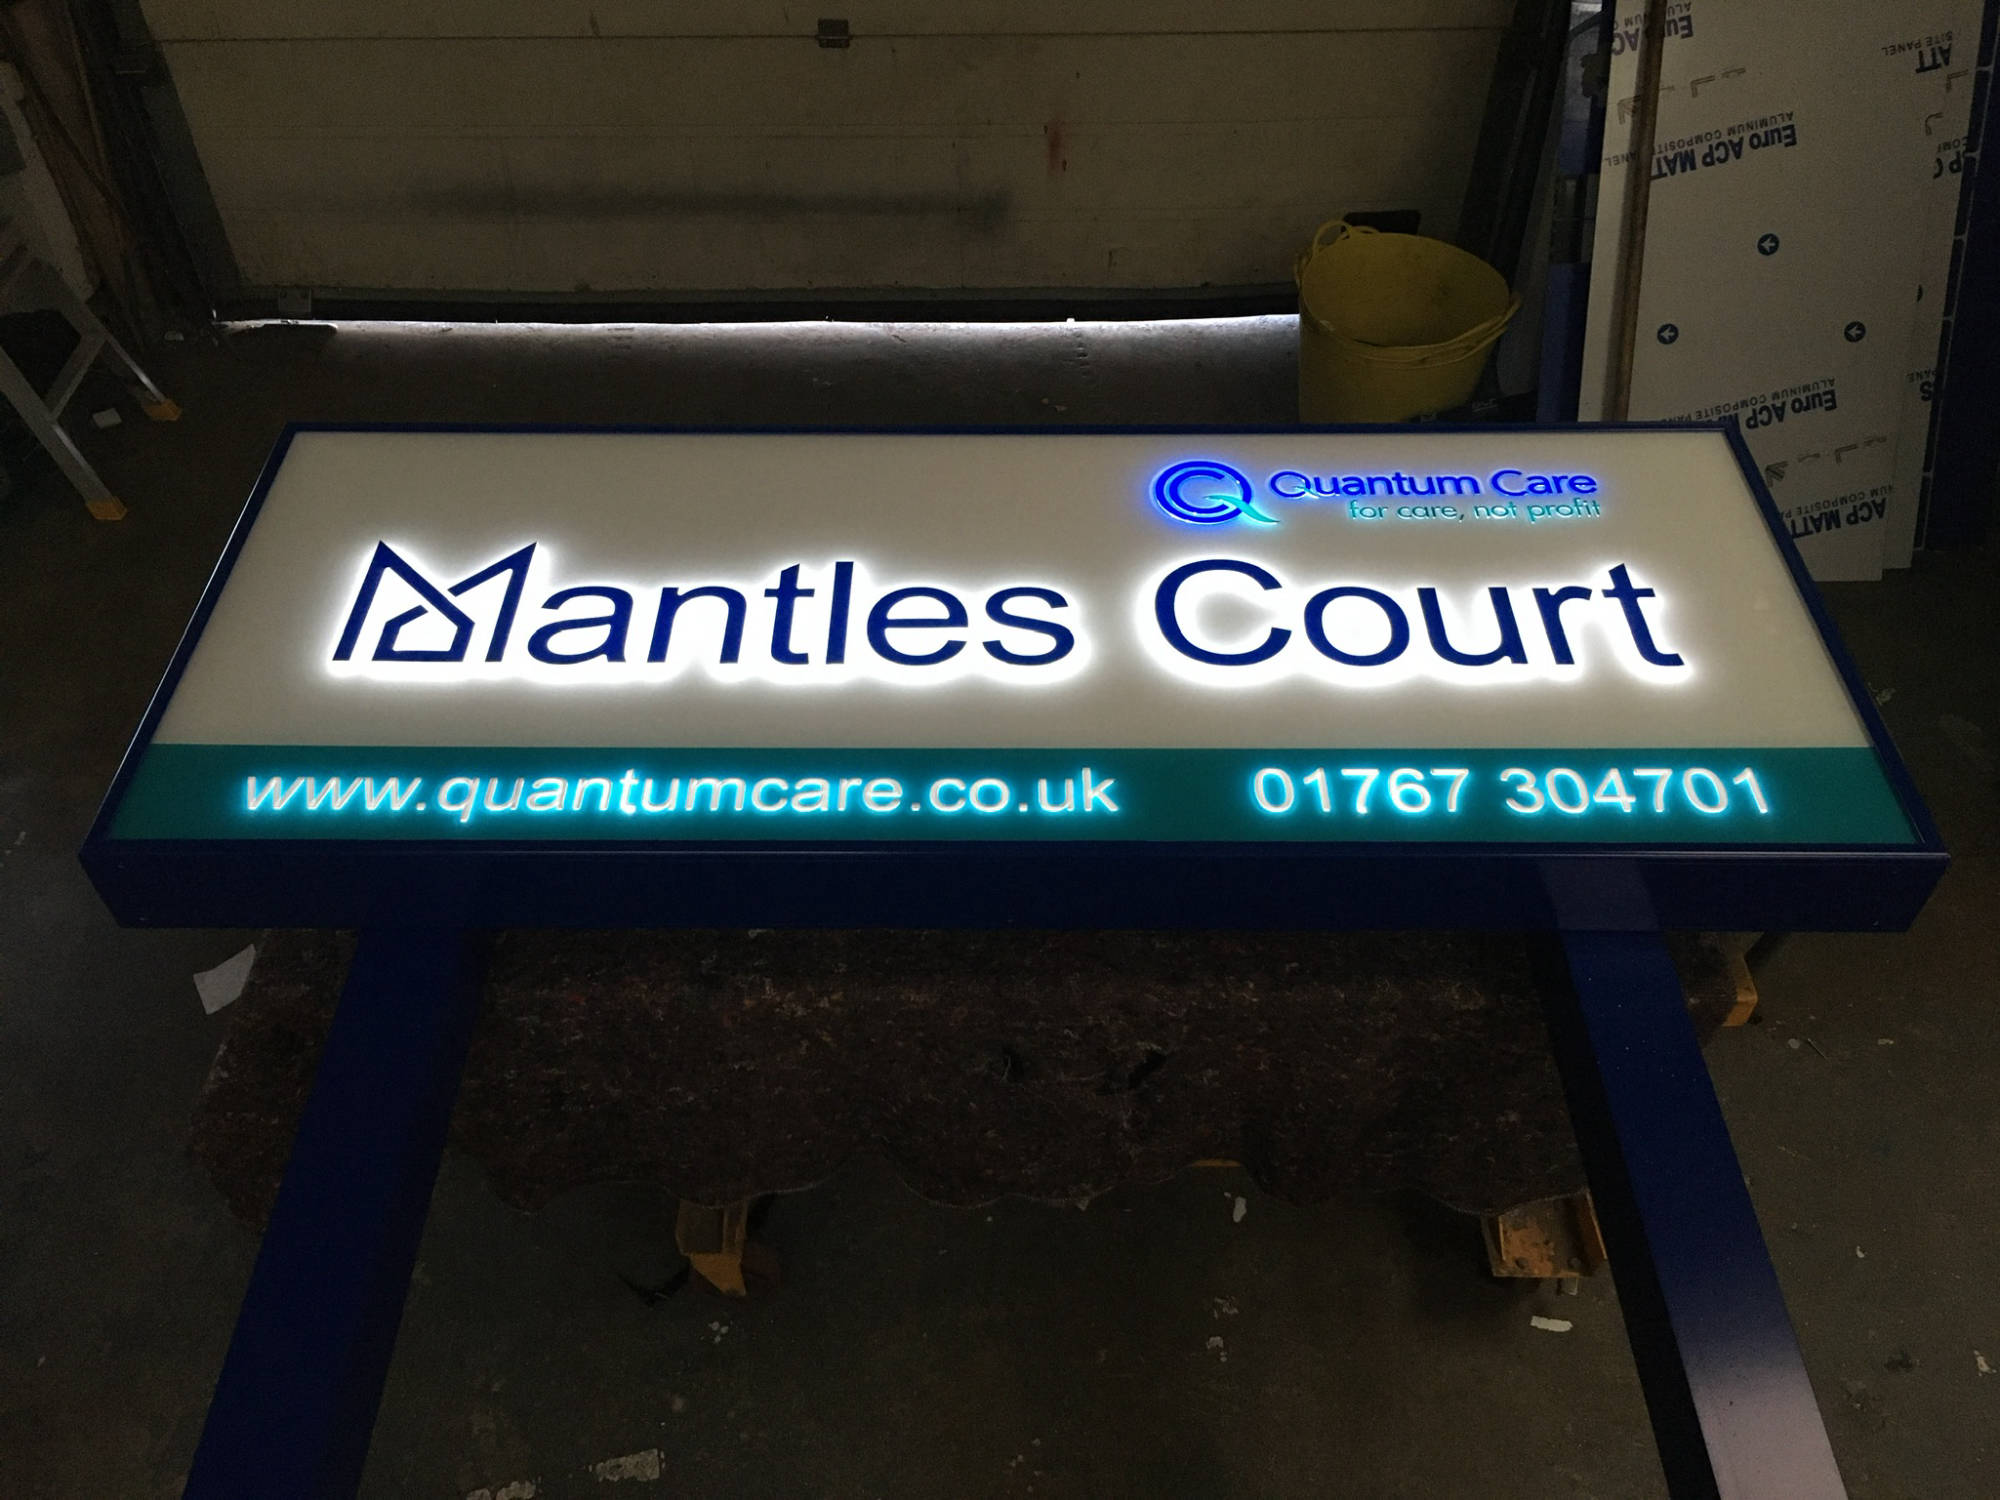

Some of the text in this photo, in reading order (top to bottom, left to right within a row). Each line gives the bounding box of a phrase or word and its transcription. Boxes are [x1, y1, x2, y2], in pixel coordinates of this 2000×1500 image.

[1915, 42, 1952, 73] ATT
[1604, 111, 1794, 168] ALUMINUM COMPOSIT ANEL
[1650, 124, 1798, 181] Euro ACP MAT
[1771, 377, 1836, 401] ALUMINUM
[1791, 389, 1837, 412] Euro
[1695, 395, 1767, 419] COMPOSITE
[1745, 401, 1786, 429] ACP
[1270, 469, 1597, 498] Quantum Care
[1349, 498, 1602, 523] for care, not profit
[1796, 491, 1866, 516] COMPOSITE
[1791, 498, 1887, 539] ACP MATT
[333, 540, 1686, 667] Mantles Court
[245, 766, 1769, 823] www.quantumcare.co.uk 01767 304701
